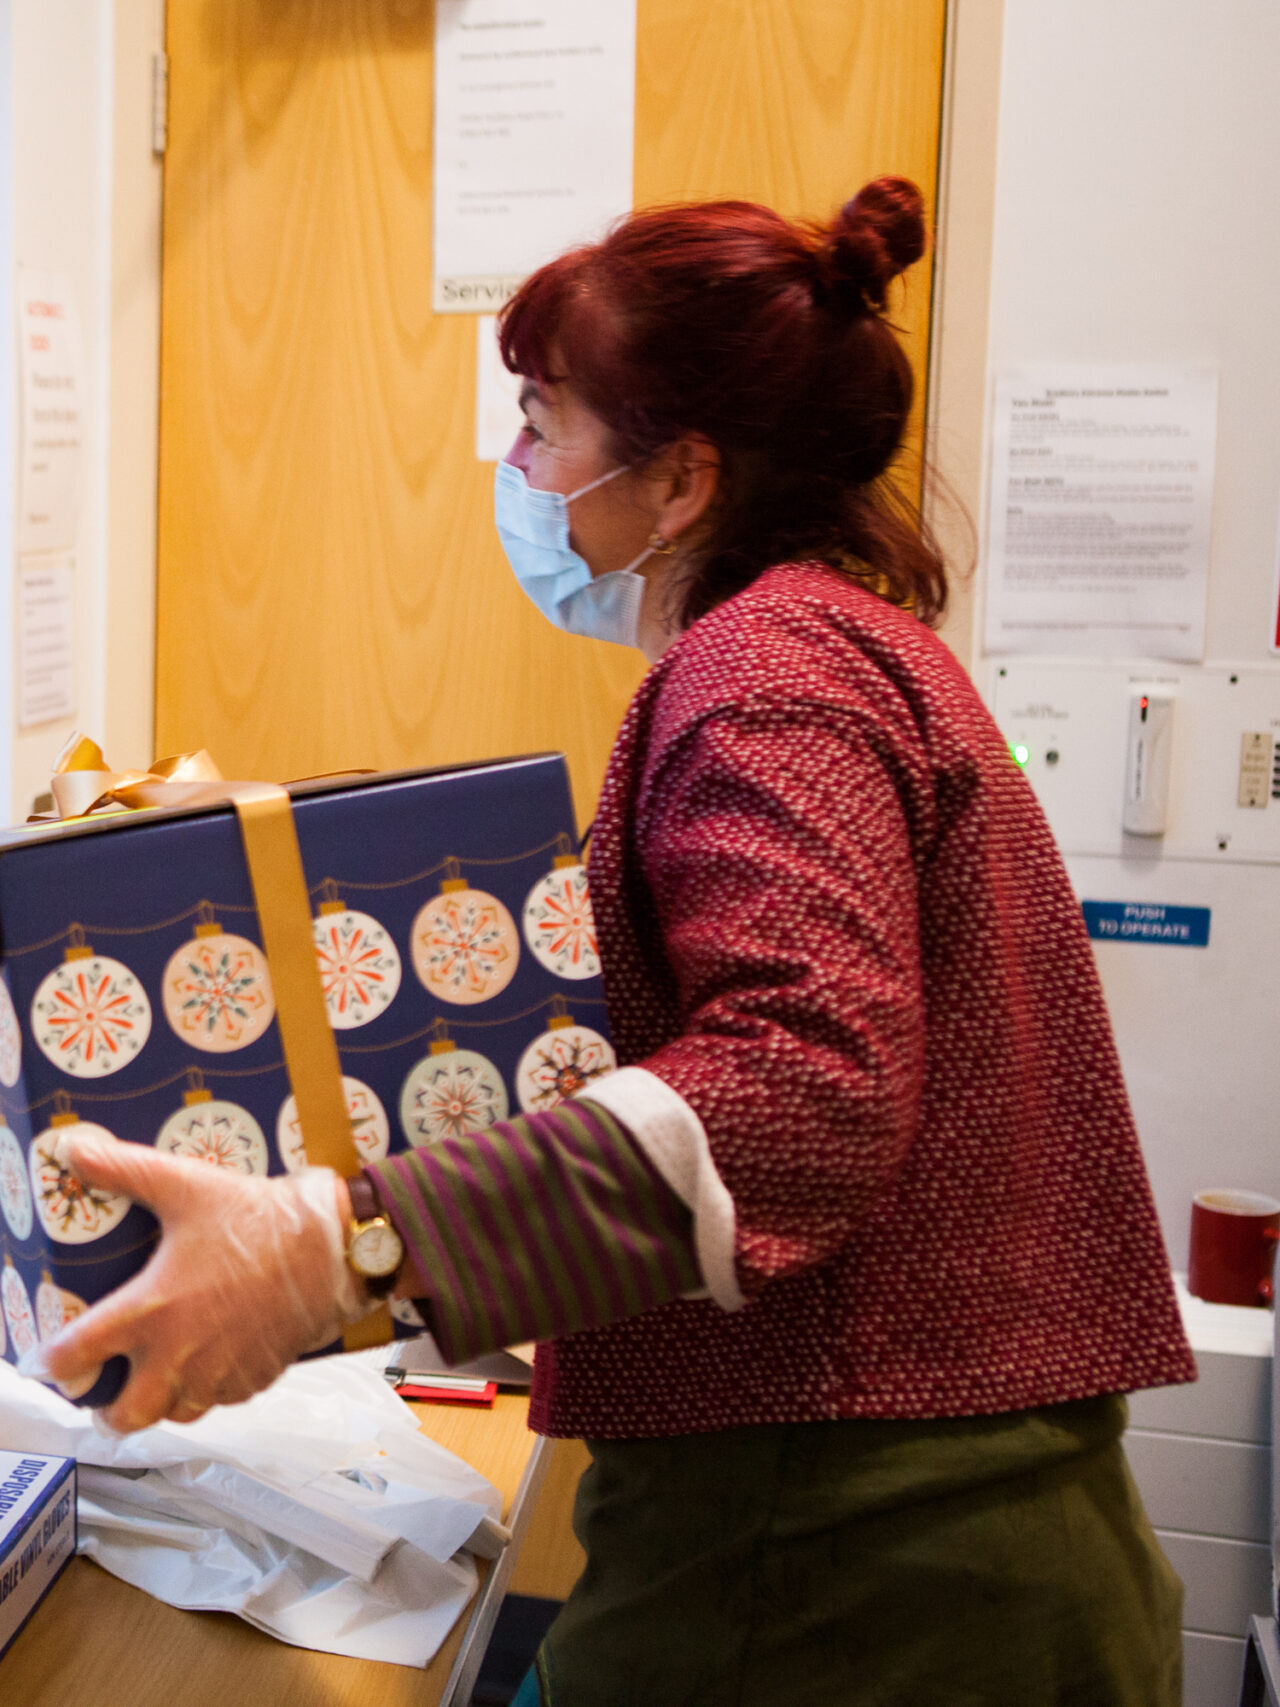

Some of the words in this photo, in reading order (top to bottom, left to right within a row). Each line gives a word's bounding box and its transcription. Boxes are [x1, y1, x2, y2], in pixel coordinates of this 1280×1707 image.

[1124, 905, 1166, 920] PUSH
[1099, 919, 1118, 935] TO
[1121, 921, 1190, 939] OPERATE
